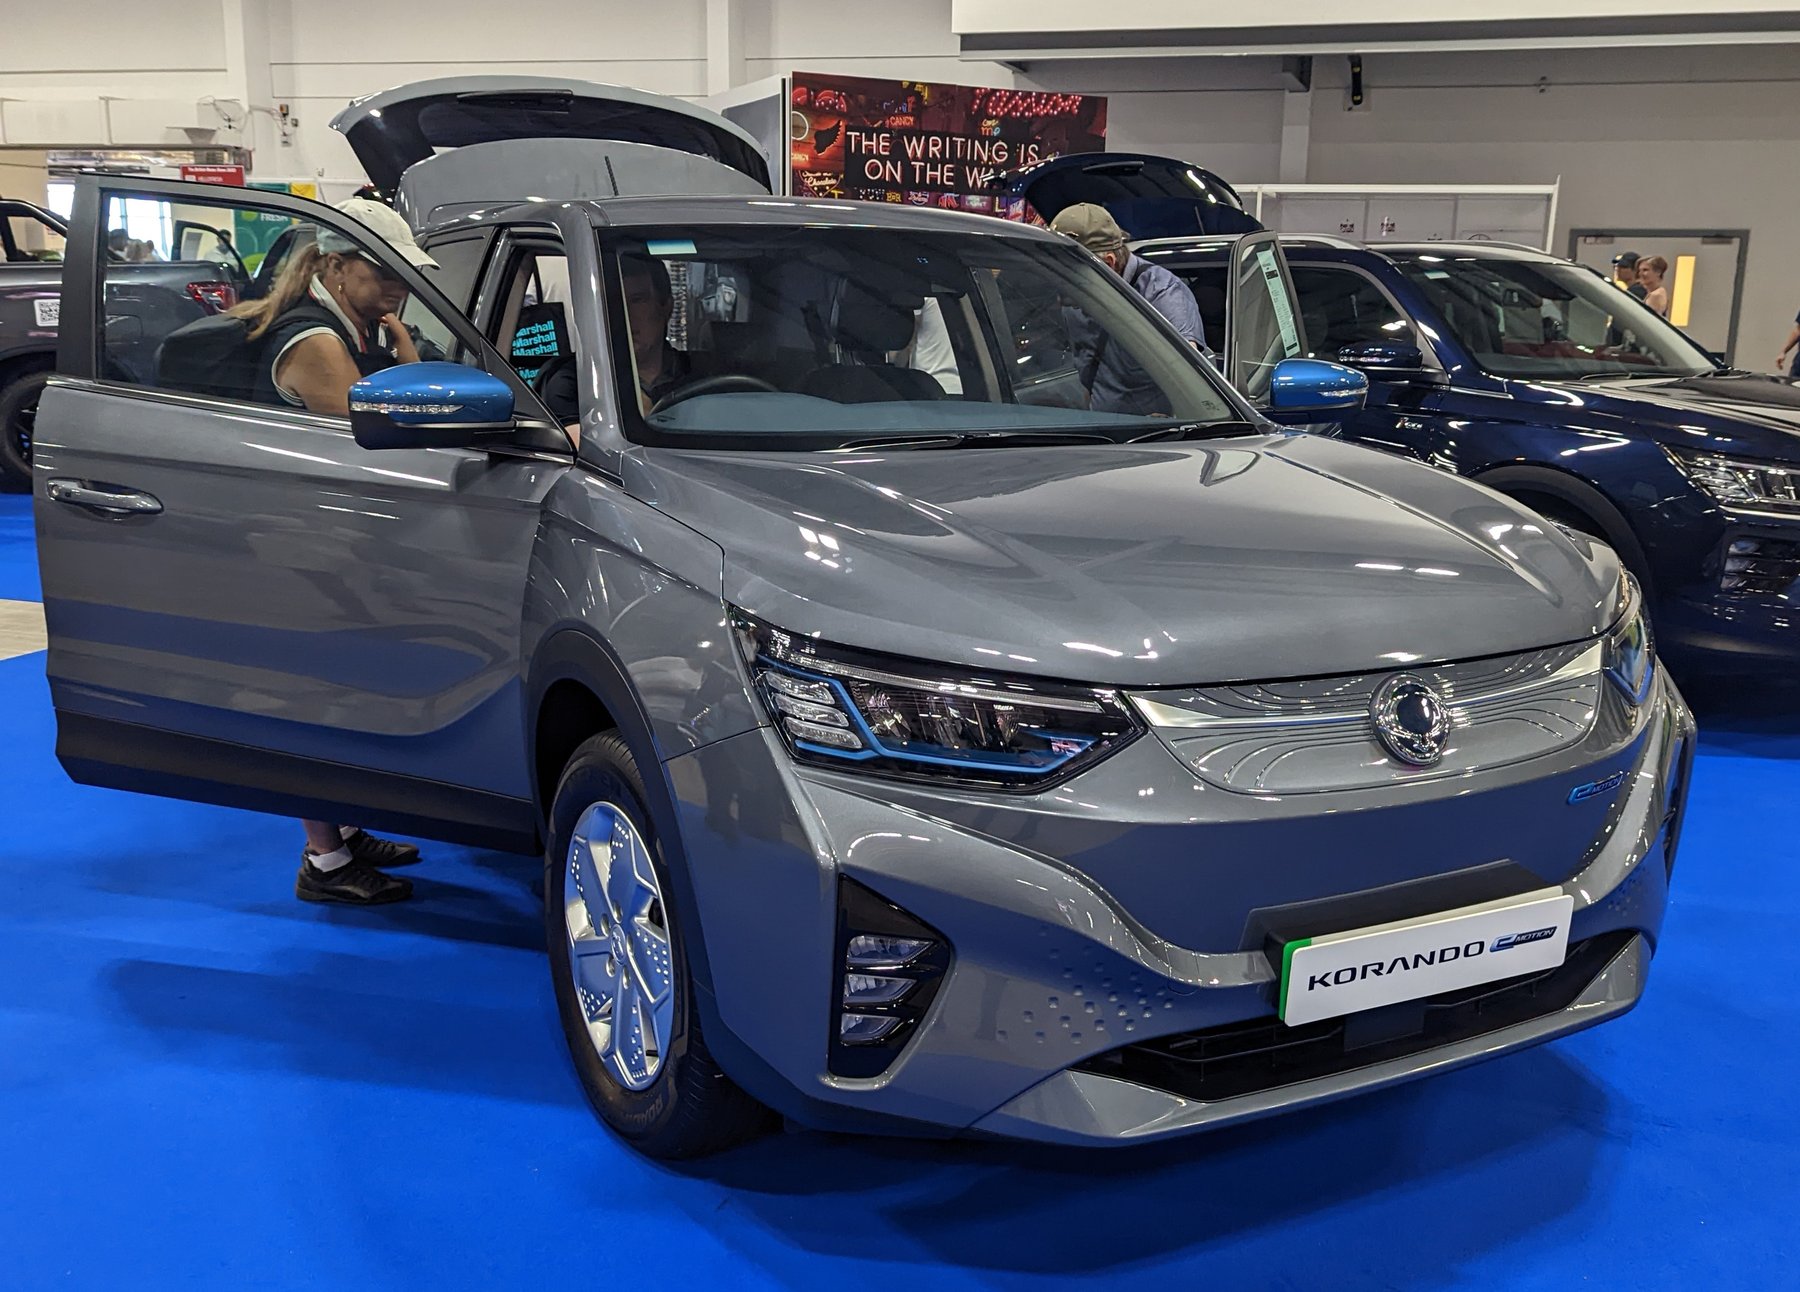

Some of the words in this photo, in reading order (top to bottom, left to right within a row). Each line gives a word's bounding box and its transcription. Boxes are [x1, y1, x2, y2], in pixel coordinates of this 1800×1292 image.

[847, 131, 890, 155] THE
[903, 134, 1008, 163] WRITING
[1019, 143, 1039, 164] IS
[864, 159, 901, 184] ON
[911, 161, 954, 186] THE
[1308, 941, 1485, 992] KORANDO
